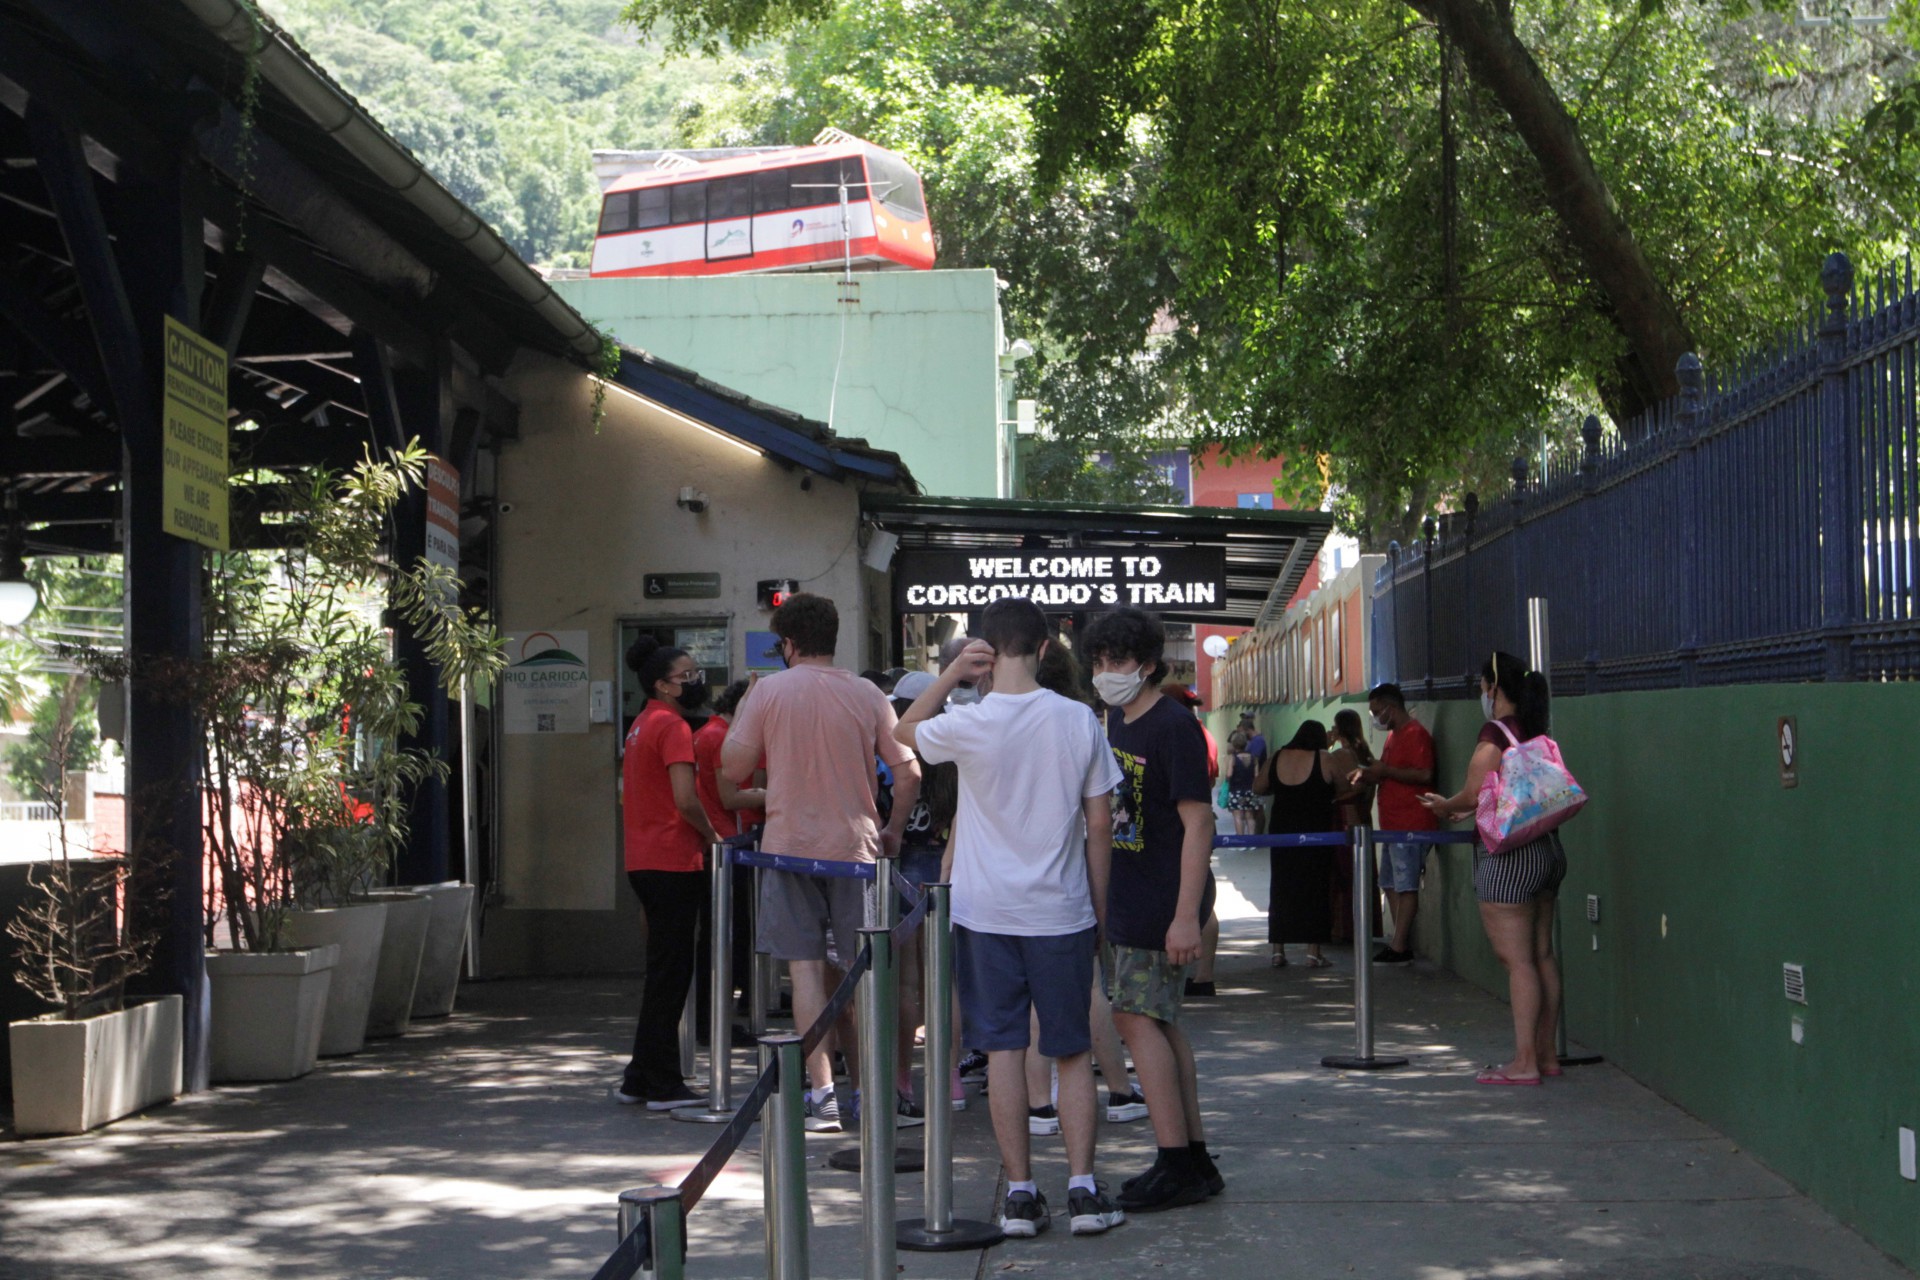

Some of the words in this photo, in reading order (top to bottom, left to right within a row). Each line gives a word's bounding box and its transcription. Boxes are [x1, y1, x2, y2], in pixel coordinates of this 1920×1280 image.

[168, 333, 224, 391] CAUTION
[167, 372, 206, 405] RENOVATION
[169, 418, 196, 447] PLEASE
[197, 431, 223, 460] EXCUSE
[165, 447, 181, 470] OUR
[182, 455, 228, 491] APPEARANCE
[183, 484, 195, 505] WE
[195, 489, 210, 511] ARE
[174, 507, 219, 541] REMODELING
[969, 557, 1113, 578] WELCOME
[1121, 556, 1162, 577] TO
[1126, 582, 1216, 604] TRAIN
[504, 671, 527, 682] RIO
[530, 670, 588, 682] CARIOCA
